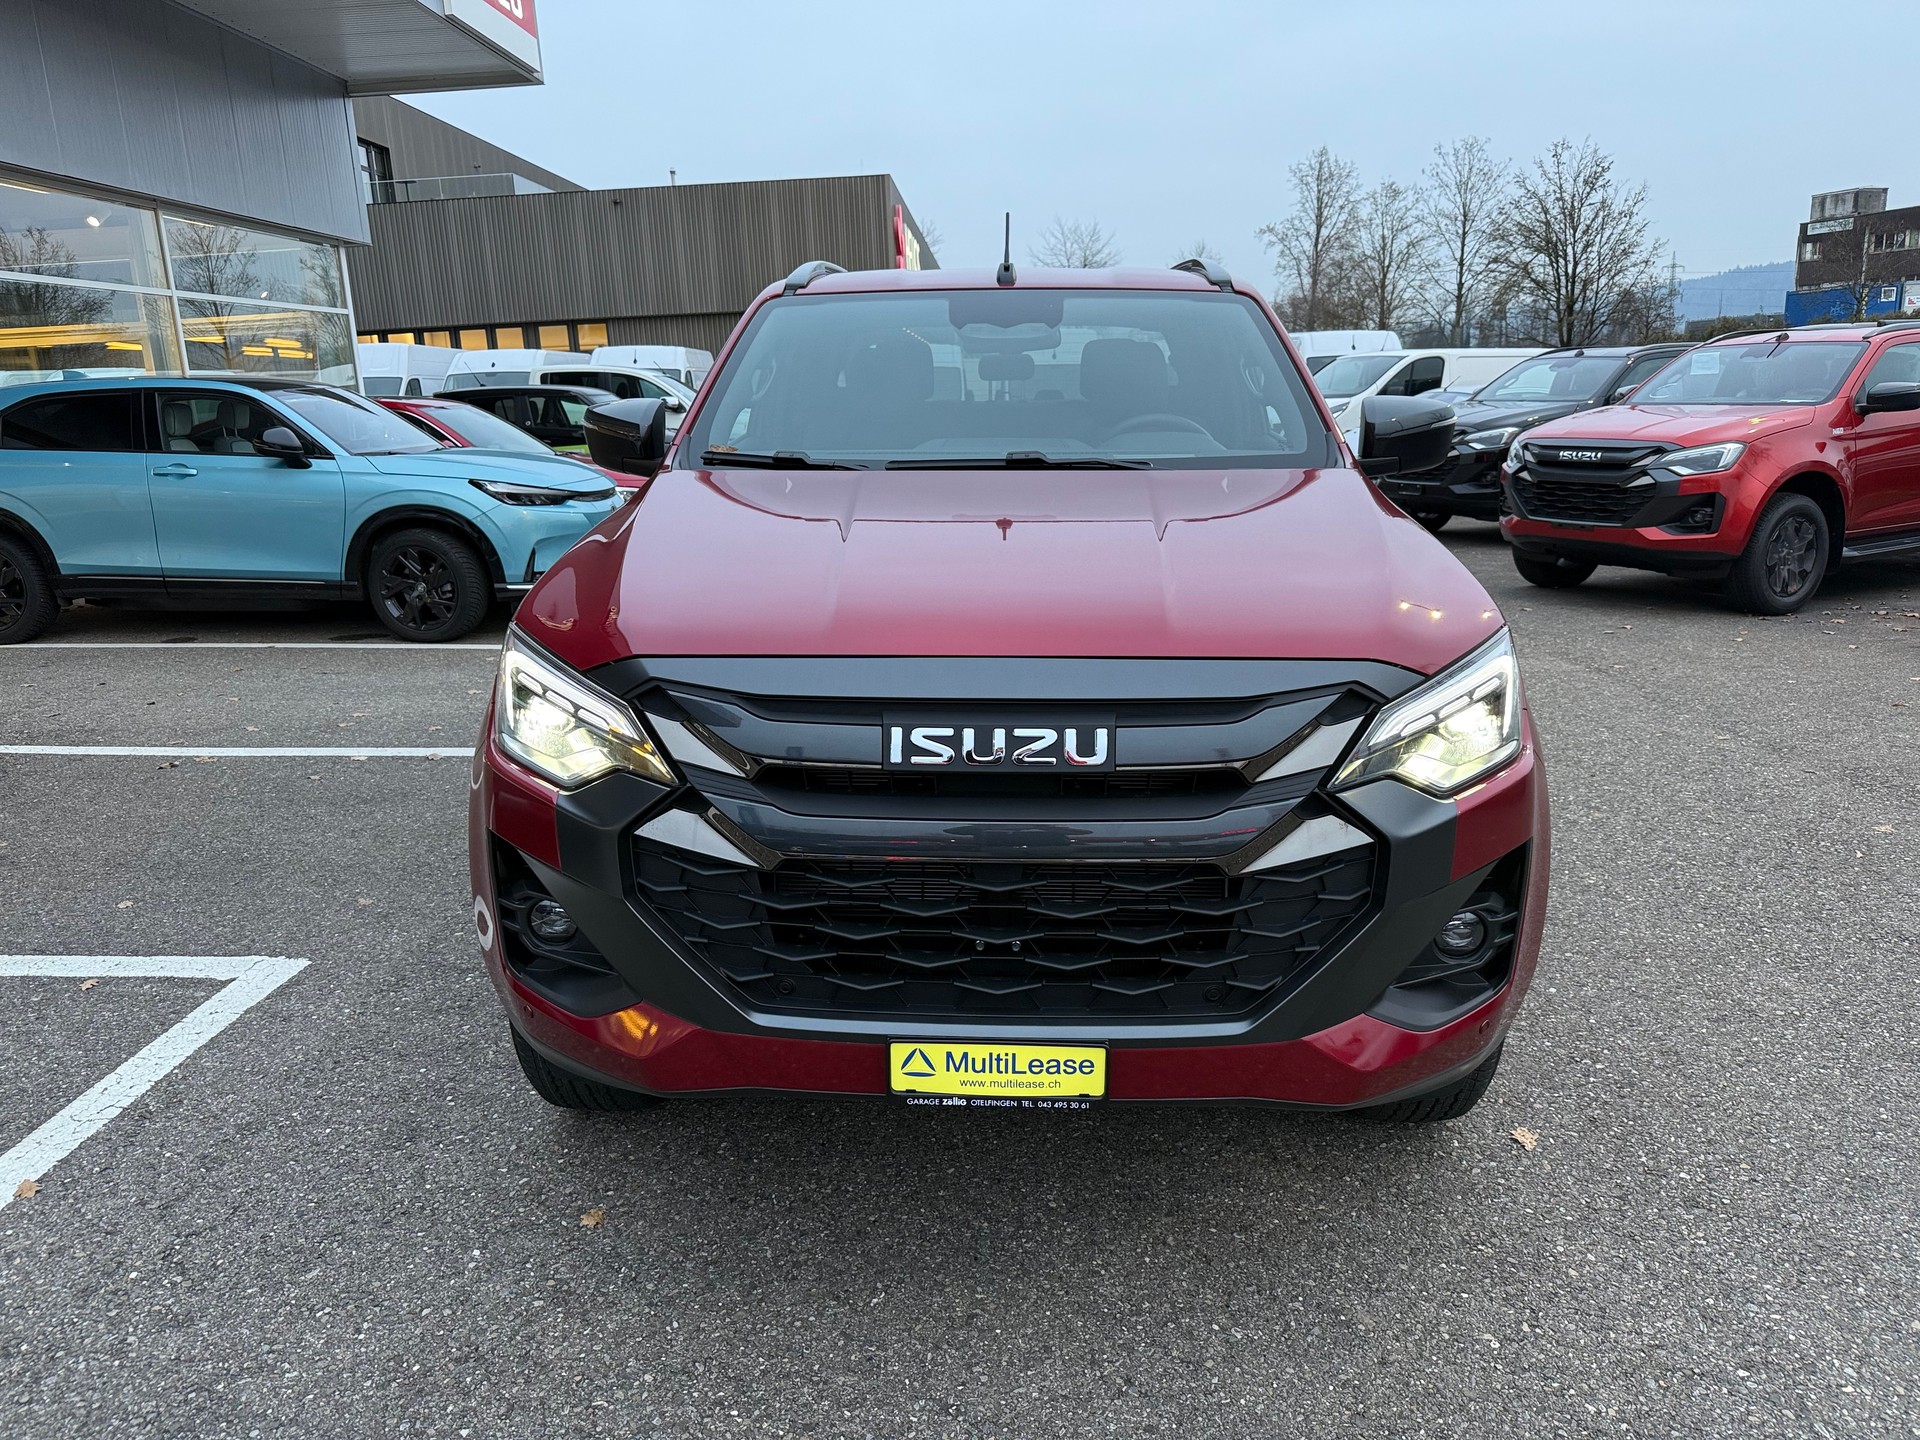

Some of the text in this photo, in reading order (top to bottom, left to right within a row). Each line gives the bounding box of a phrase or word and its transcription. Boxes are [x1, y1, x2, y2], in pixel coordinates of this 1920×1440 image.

[1559, 450, 1602, 461] ISUZU
[889, 726, 1109, 766] ISUZU
[945, 1051, 1095, 1075] MultiLease
[959, 1079, 1061, 1089] www.multilease.ch
[906, 1098, 940, 1106] GARAGE
[970, 1099, 1018, 1107] OTELFINGEN
[1053, 1101, 1068, 1109] 495
